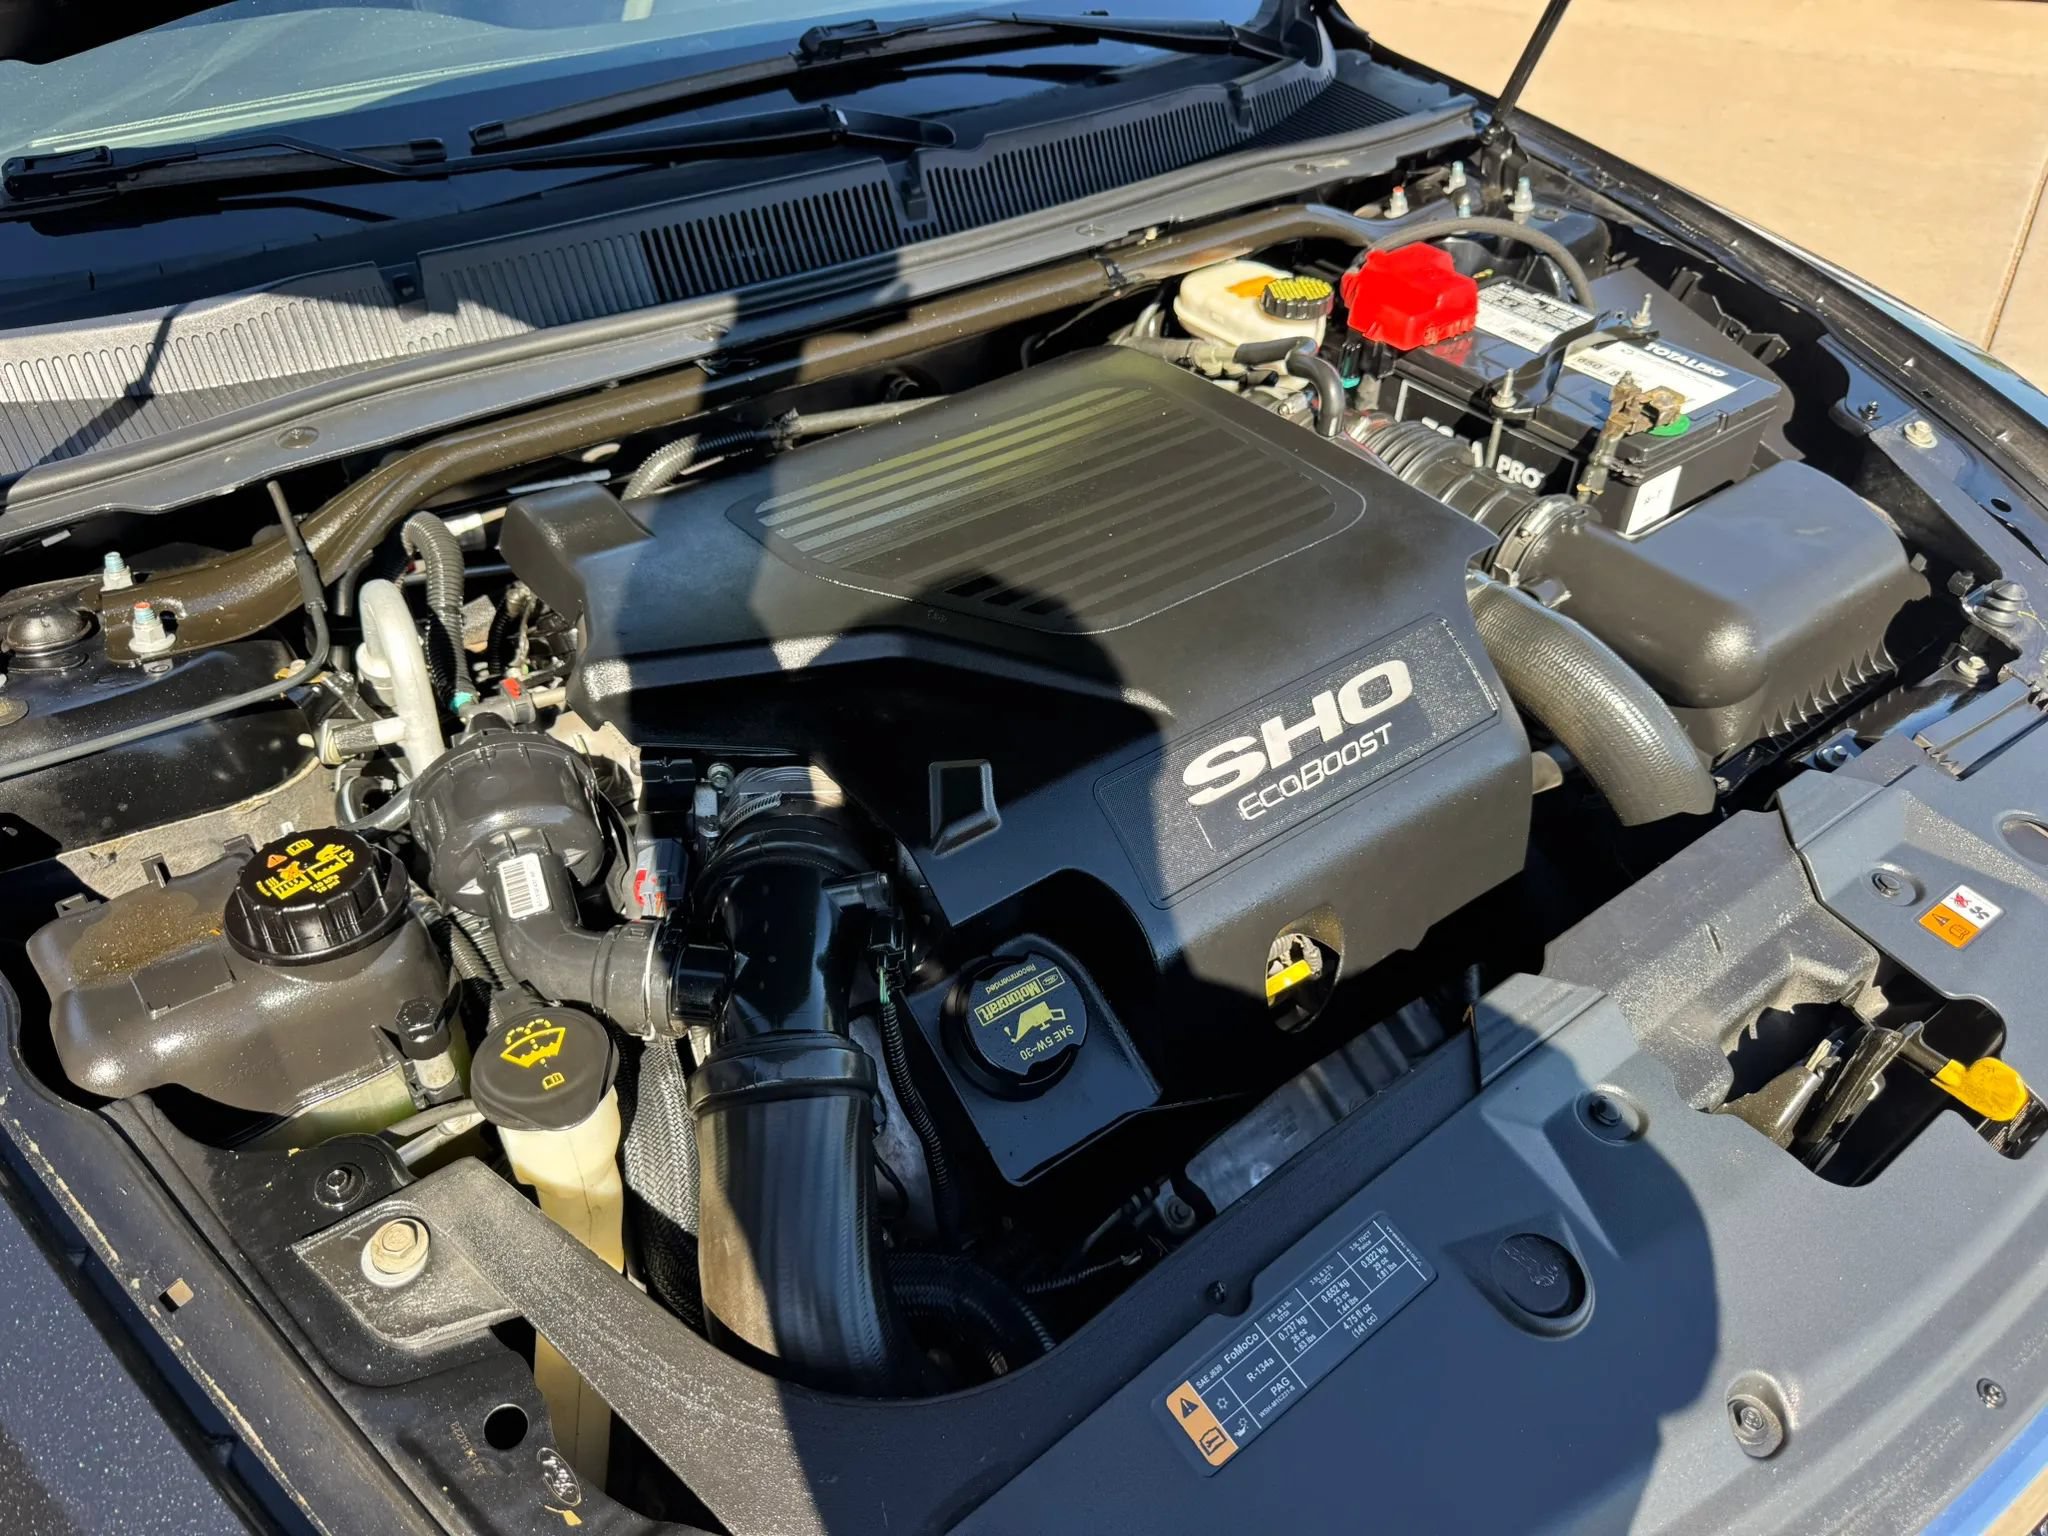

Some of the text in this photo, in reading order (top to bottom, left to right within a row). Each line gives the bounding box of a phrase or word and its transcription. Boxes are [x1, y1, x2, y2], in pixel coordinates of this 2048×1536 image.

[1497, 455, 1543, 489] PRO
[1182, 660, 1413, 807] SHO
[985, 963, 1037, 995] Recommended
[977, 979, 1043, 1021] Motorcraft
[1020, 1024, 1074, 1061] SAE 5W-30
[1377, 1245, 1389, 1257] kg
[1387, 1262, 1398, 1274] lbs
[1320, 1278, 1351, 1303] 0.652 kg
[1337, 1296, 1359, 1316] 1.44 lbs
[1343, 1314, 1358, 1330] 4.75
[1362, 1303, 1373, 1314] oz
[1277, 1315, 1308, 1341] 0.737 kg
[1351, 1313, 1379, 1339] (141 cc)
[1306, 1334, 1317, 1345] lbs
[1196, 1374, 1210, 1389] SAE
[1223, 1333, 1260, 1364] FoMoCo
[1246, 1357, 1275, 1382] R-134a
[1270, 1377, 1290, 1396] PAG
